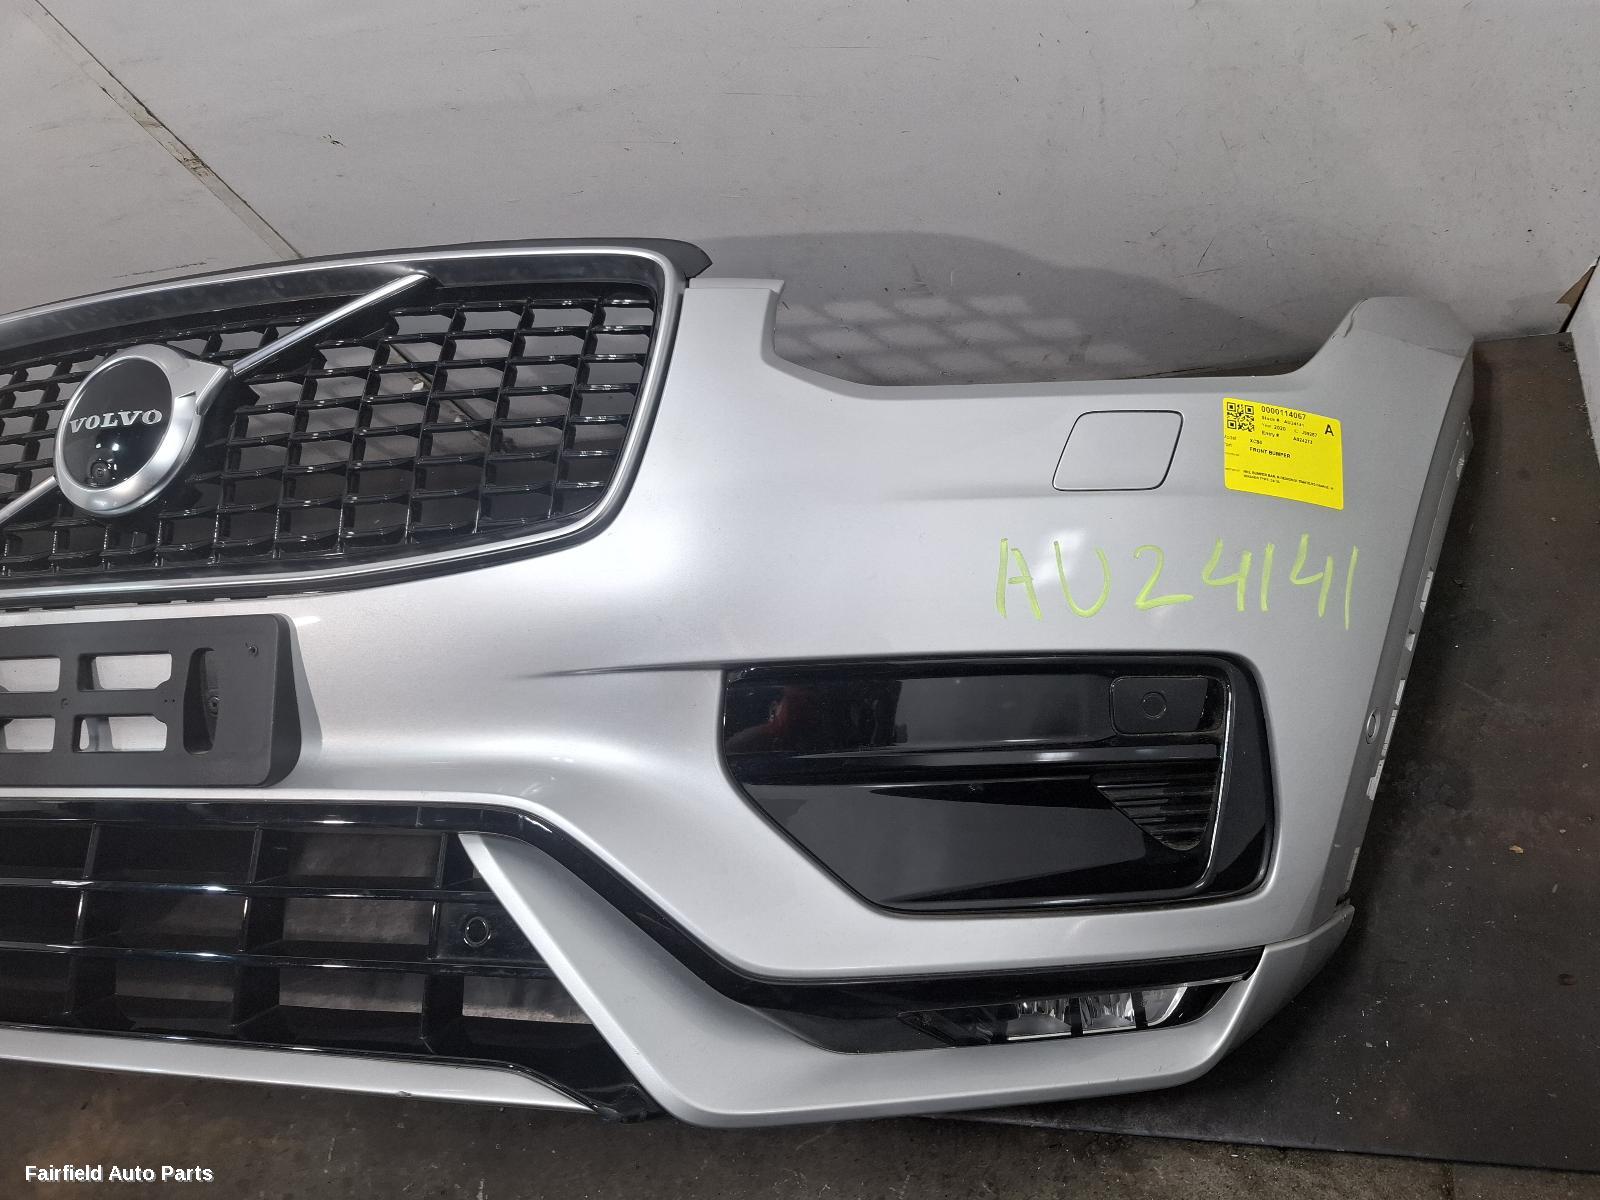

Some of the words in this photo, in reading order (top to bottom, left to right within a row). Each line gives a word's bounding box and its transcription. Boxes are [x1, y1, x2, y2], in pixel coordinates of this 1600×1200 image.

[69, 408, 163, 434] VOLVO
[1261, 405, 1306, 421] 0000114067
[1324, 423, 1335, 437] A
[1249, 446, 1268, 454] FRONT
[1268, 450, 1291, 459] BUMPER
[995, 533, 1359, 630] AU24141
